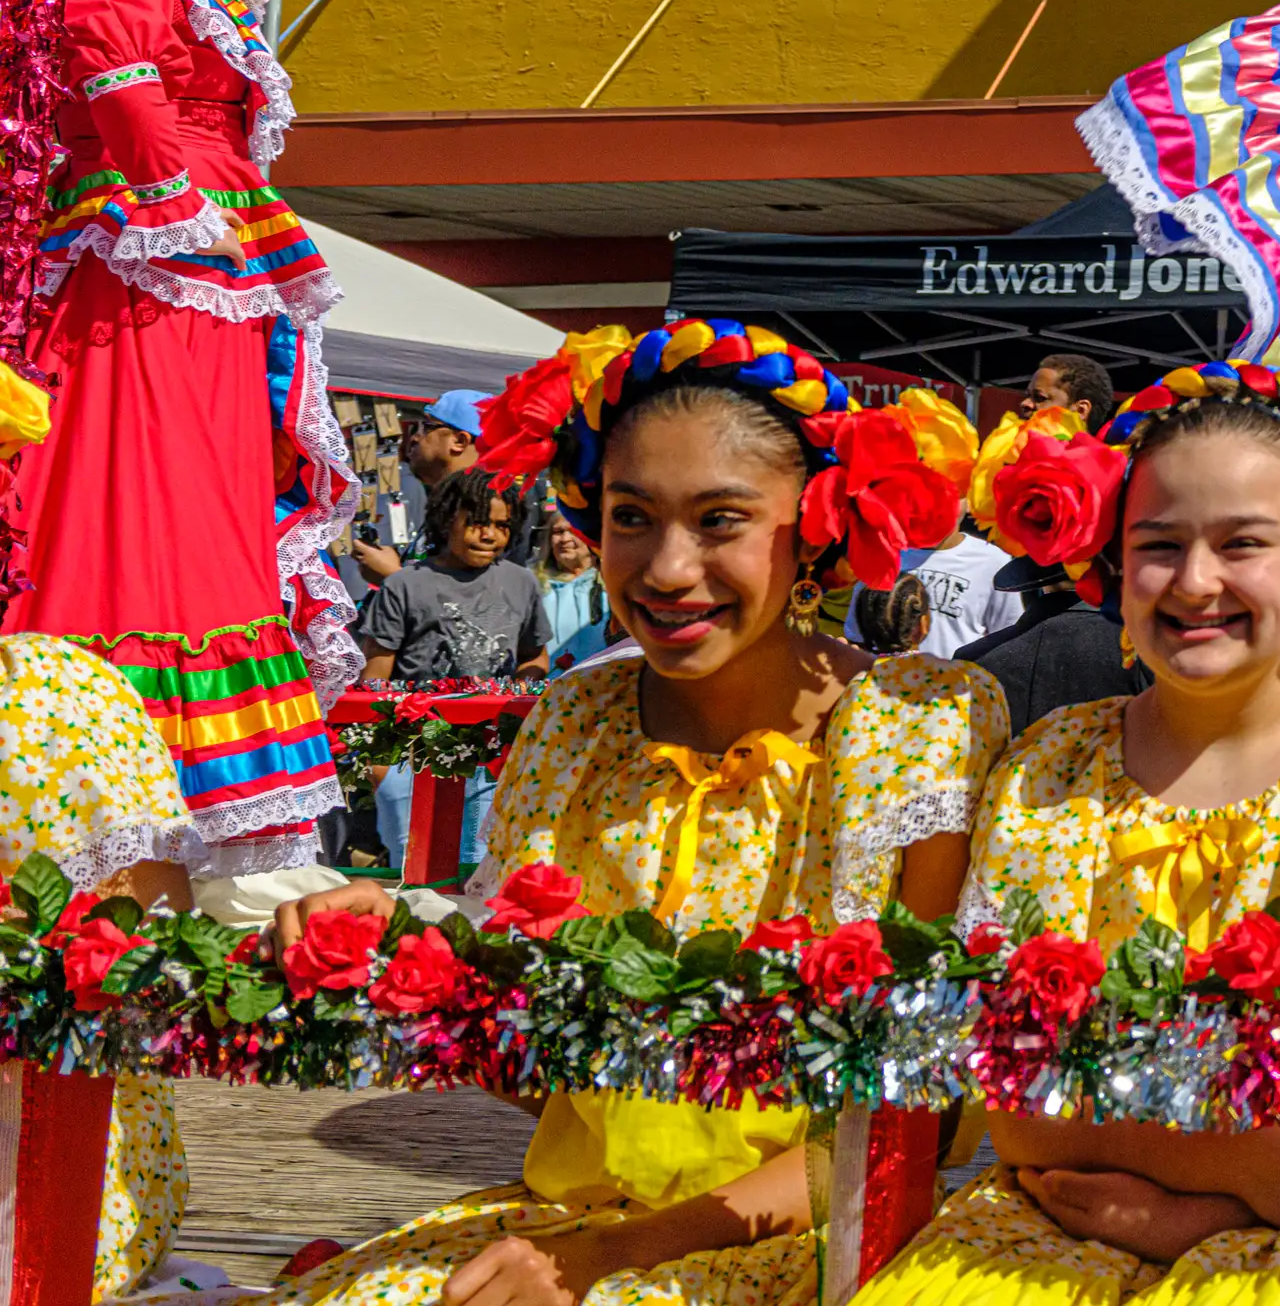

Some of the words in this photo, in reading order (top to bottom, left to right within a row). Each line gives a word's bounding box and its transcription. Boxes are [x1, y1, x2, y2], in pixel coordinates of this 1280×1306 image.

[916, 245, 1116, 295] Edward
[1119, 245, 1245, 300] Jon
[839, 375, 945, 407] Tru
